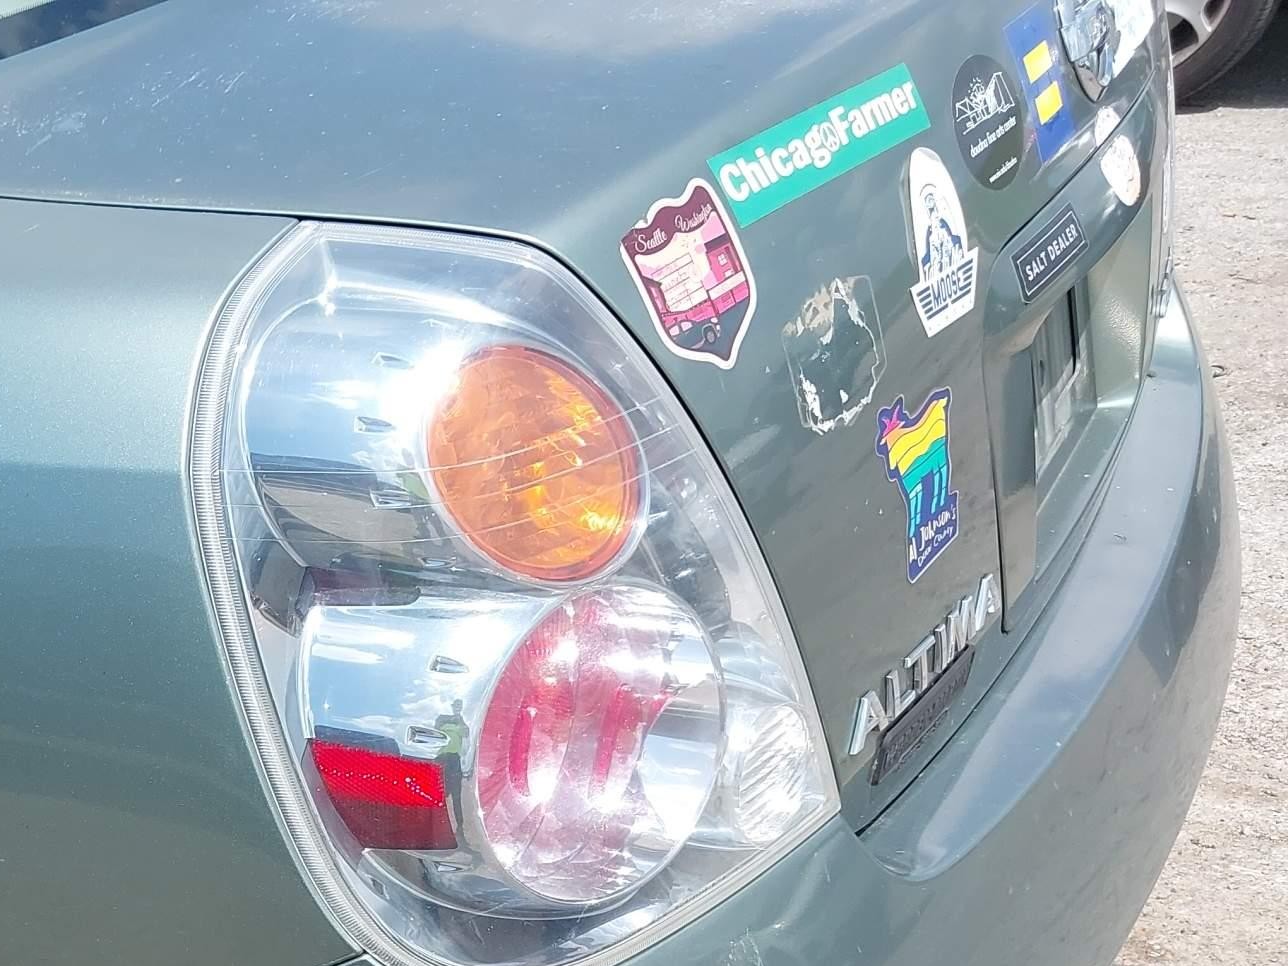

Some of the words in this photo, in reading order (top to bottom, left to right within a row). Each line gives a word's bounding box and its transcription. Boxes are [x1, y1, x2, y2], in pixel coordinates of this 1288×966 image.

[635, 228, 668, 253] Seattle
[1025, 251, 1048, 281] SALT
[1047, 223, 1078, 261] DEALER
[931, 268, 964, 309] MOOSE
[918, 504, 957, 551] Johnson's
[848, 572, 1002, 755] ALTIMA
